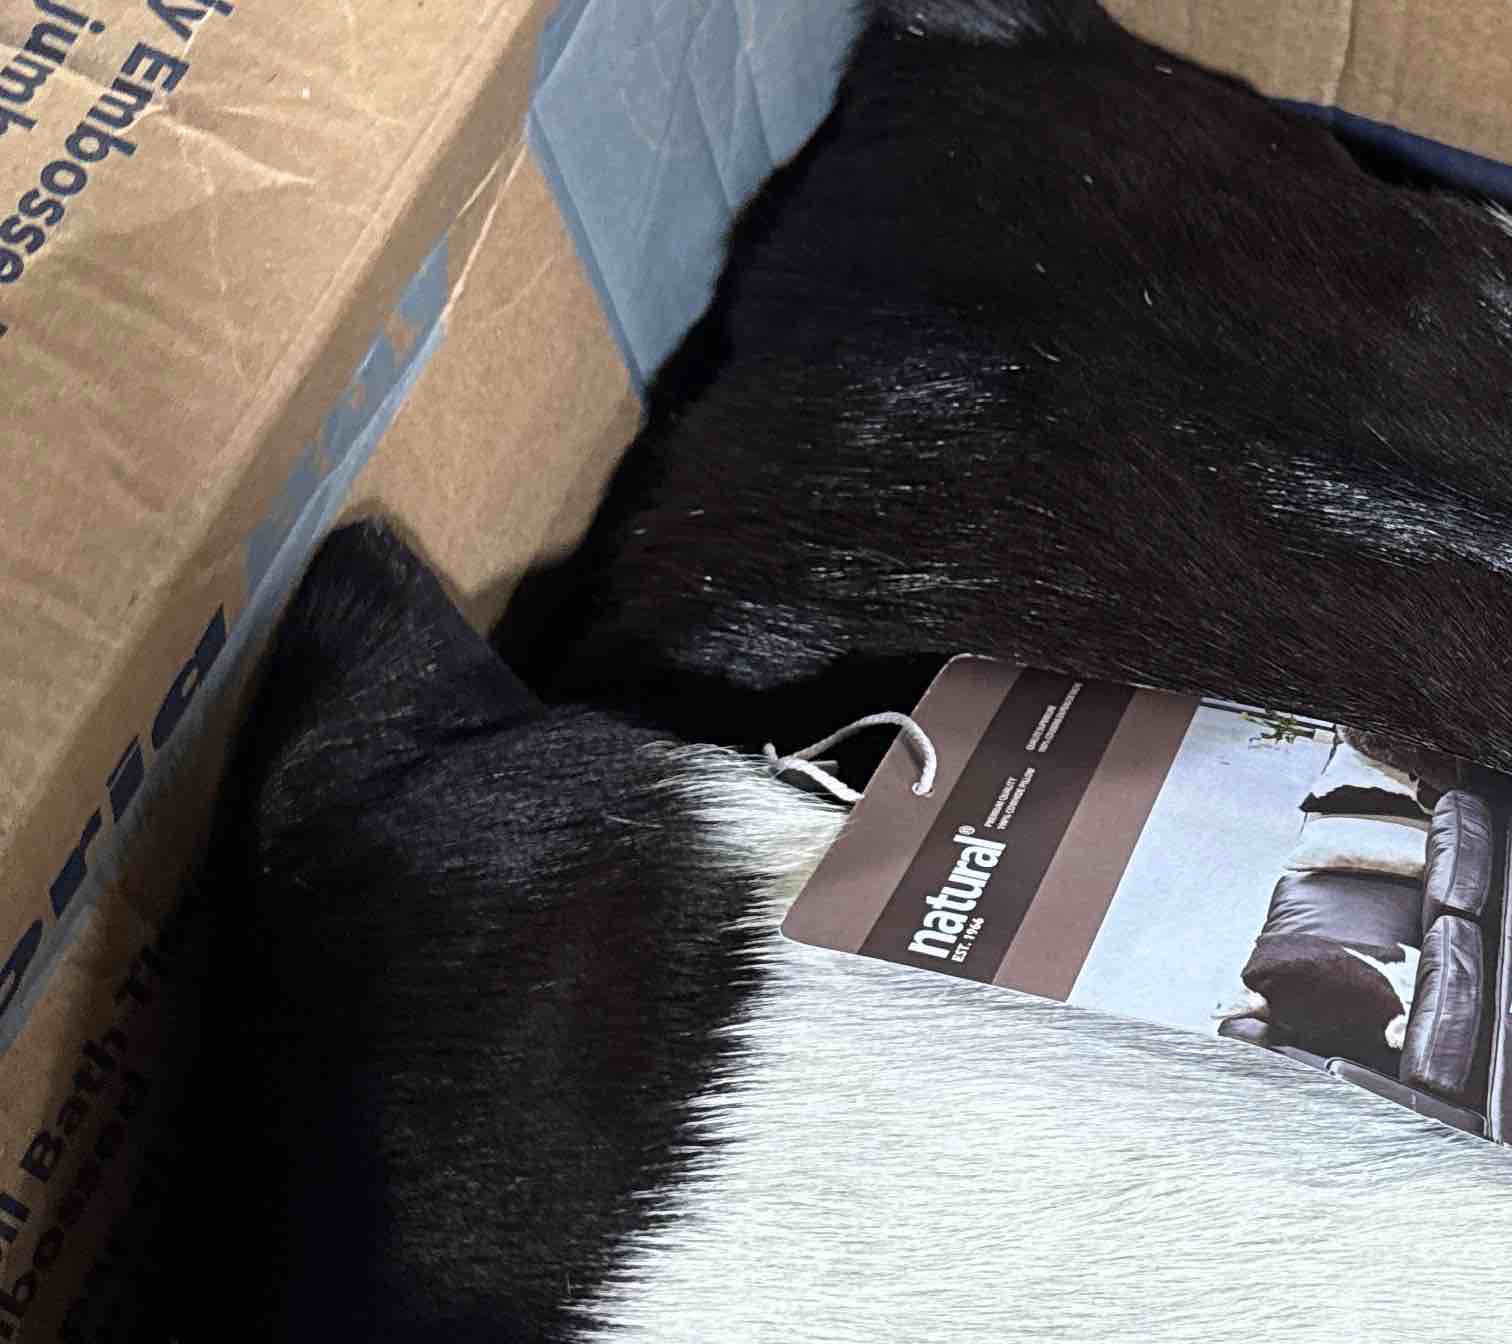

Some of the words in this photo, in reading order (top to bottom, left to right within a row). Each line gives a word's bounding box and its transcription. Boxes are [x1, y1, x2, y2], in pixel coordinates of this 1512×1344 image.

[0, 40, 191, 286] Embosse
[951, 936, 974, 964] EST.
[965, 916, 985, 941] 1966
